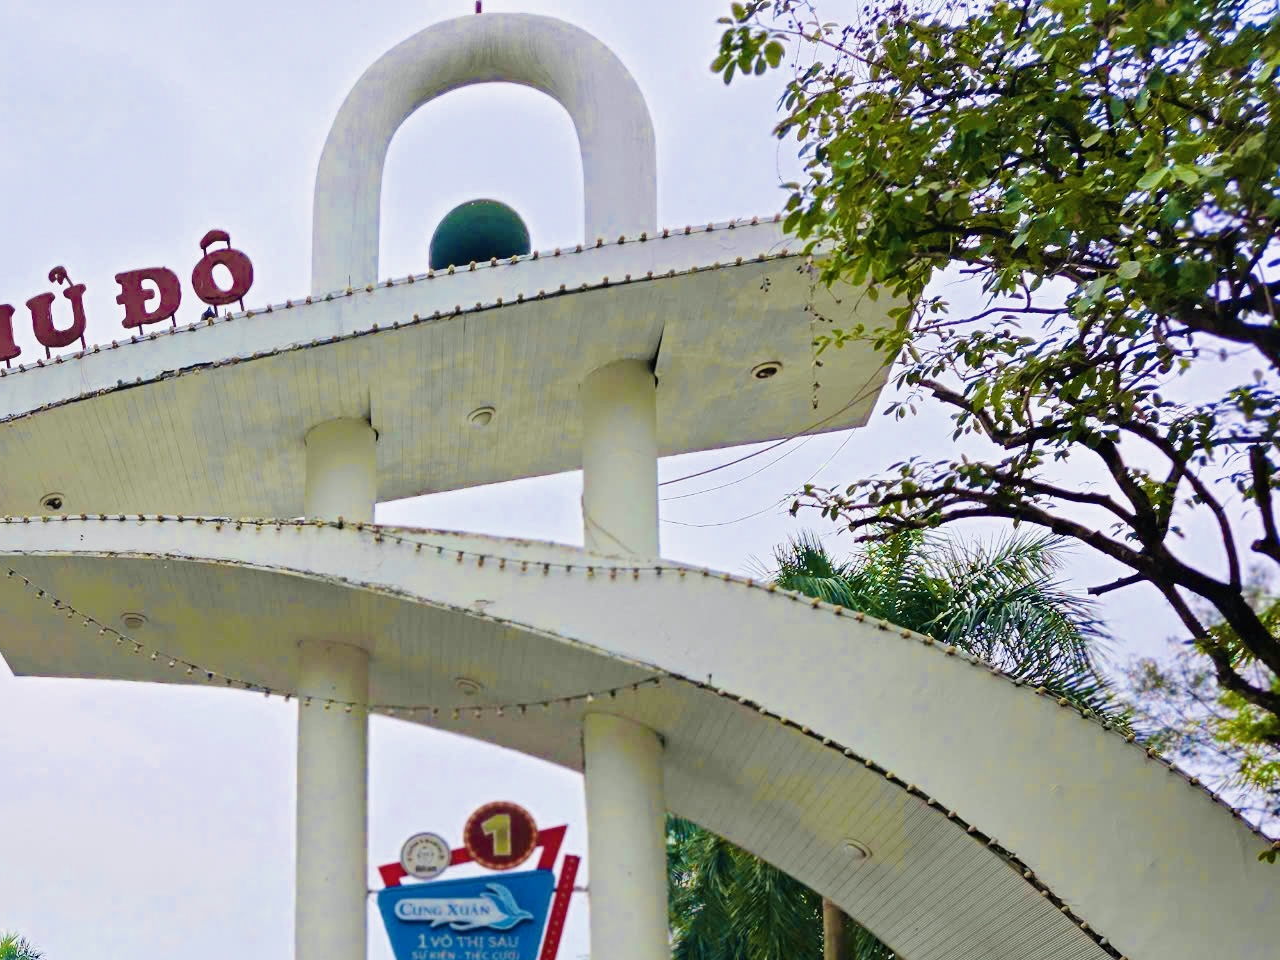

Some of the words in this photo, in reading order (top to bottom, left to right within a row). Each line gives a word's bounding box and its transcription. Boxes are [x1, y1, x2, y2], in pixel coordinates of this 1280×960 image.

[115, 228, 254, 329] ĐÔ
[481, 813, 512, 857] 1
[417, 933, 427, 949] 1
